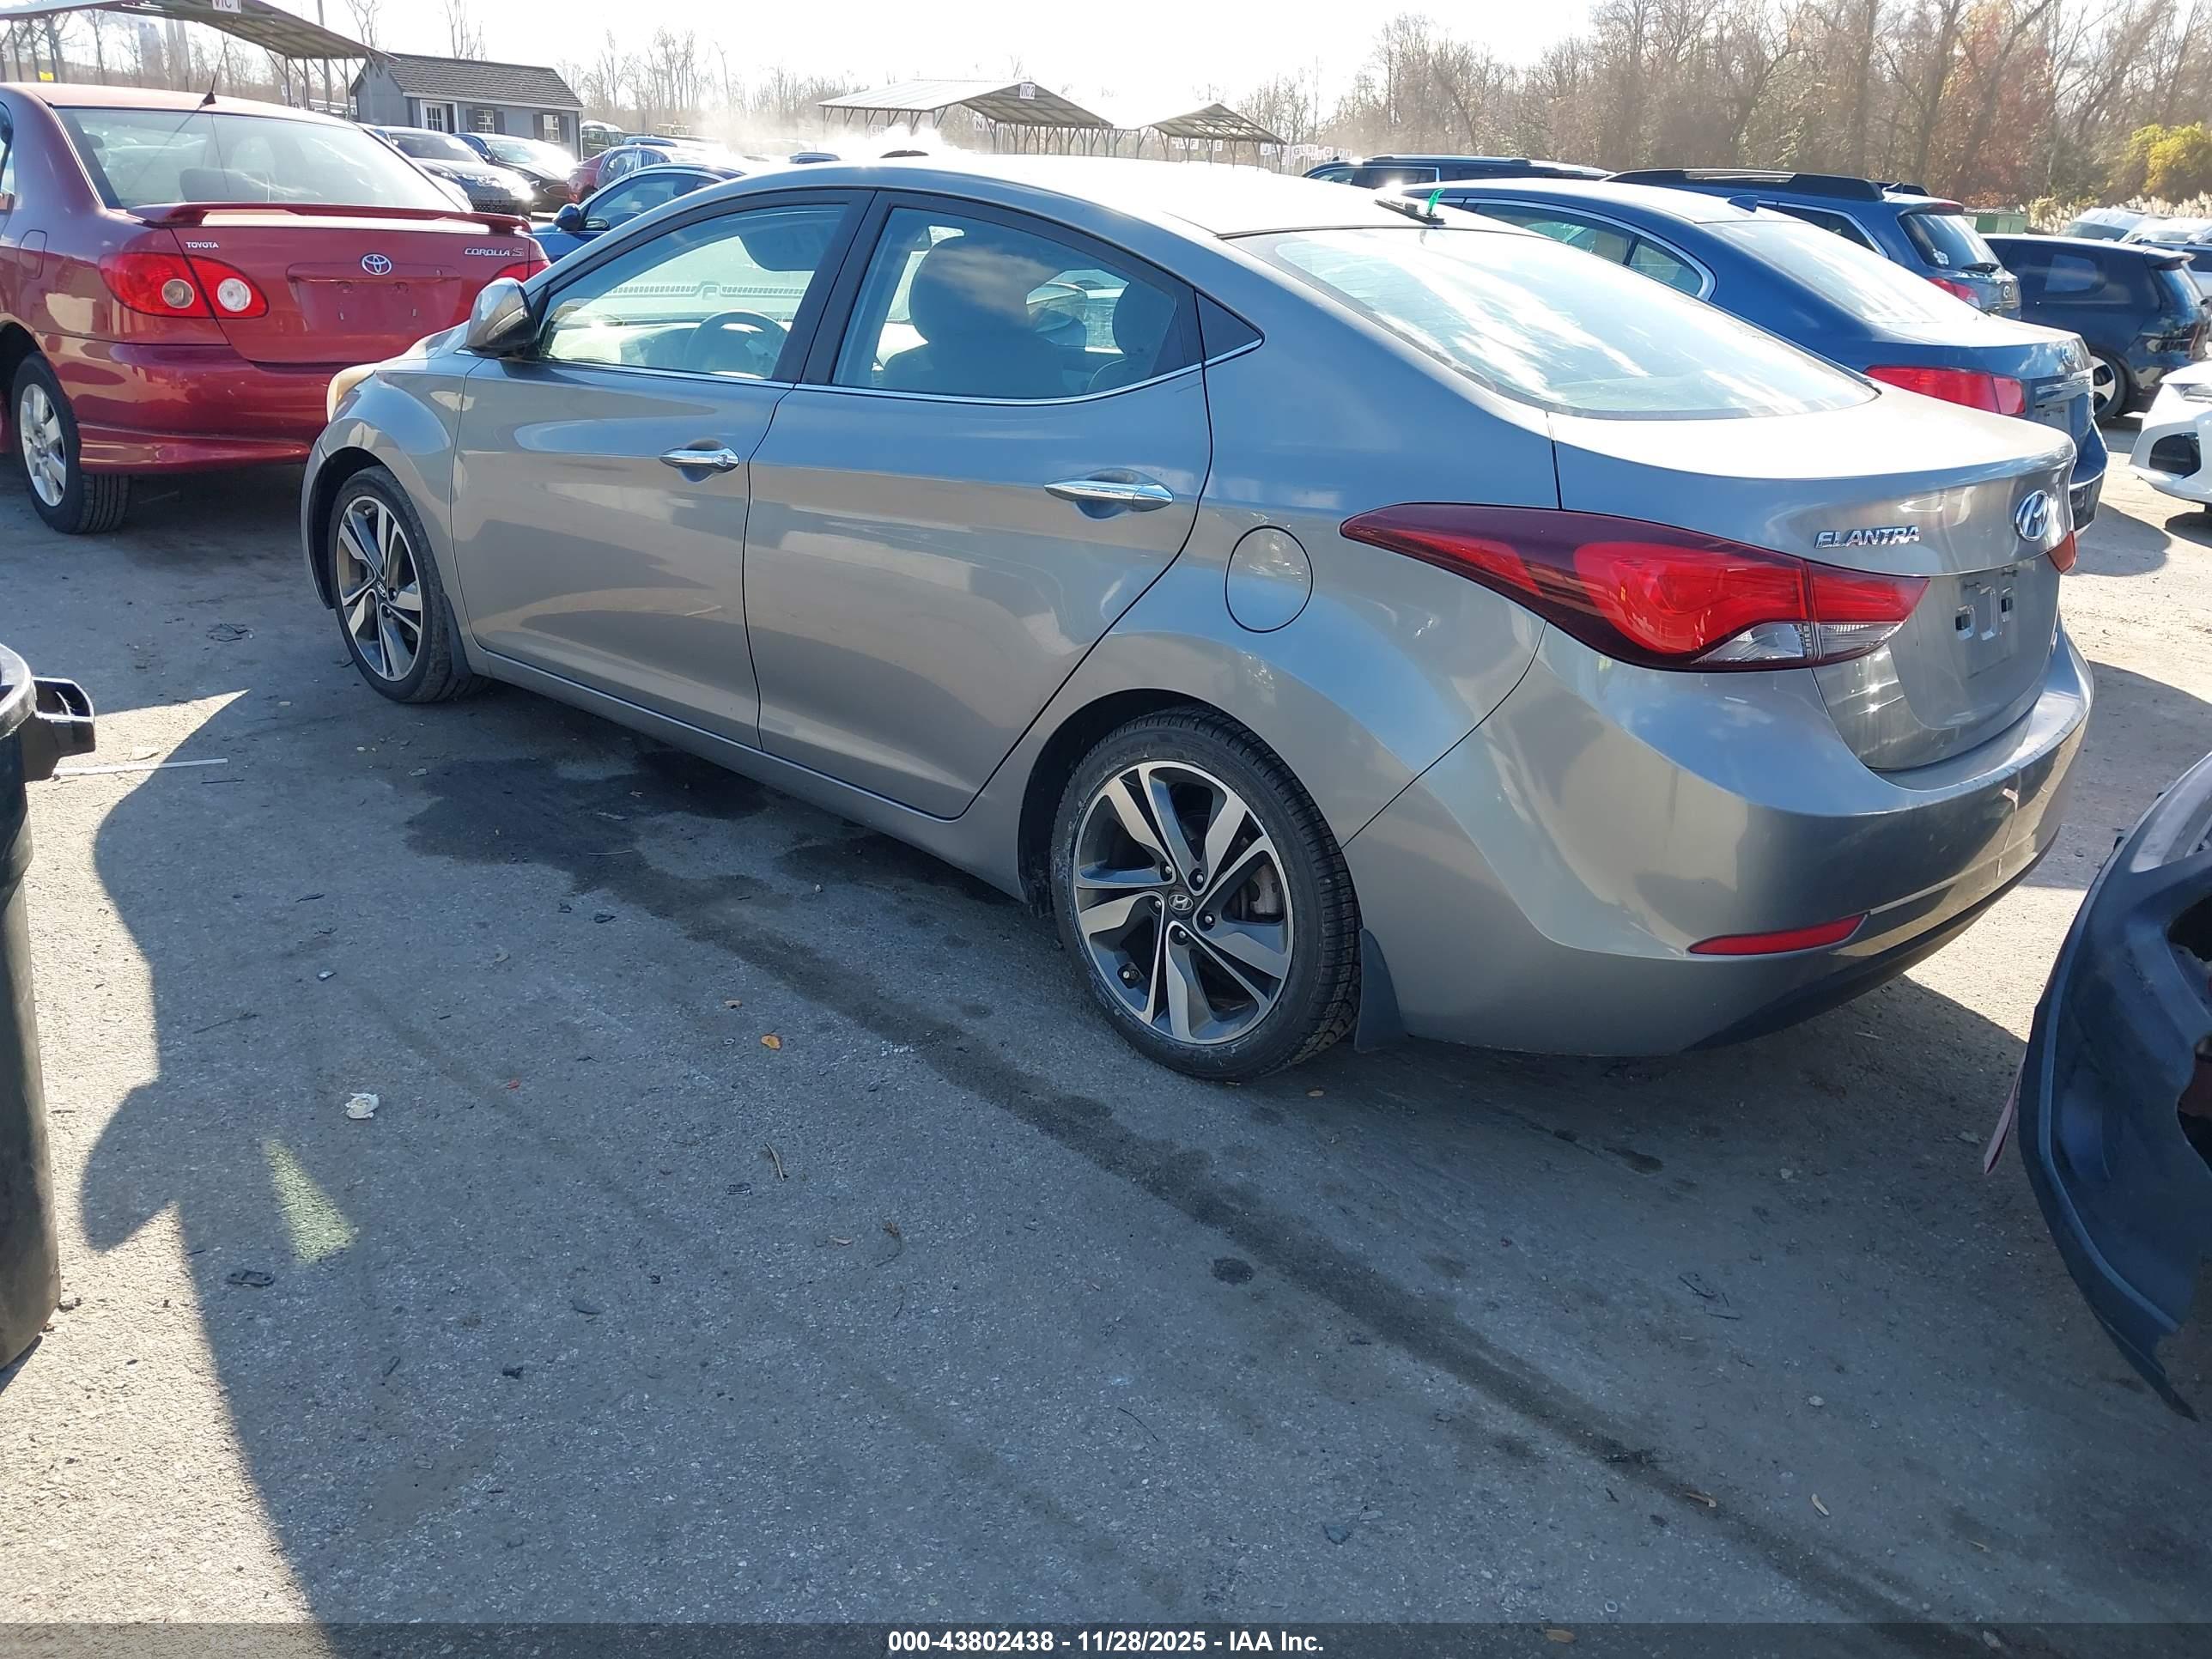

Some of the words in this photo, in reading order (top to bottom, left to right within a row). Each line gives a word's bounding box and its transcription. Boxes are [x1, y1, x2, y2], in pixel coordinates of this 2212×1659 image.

[464, 246, 511, 257] COROLLA
[511, 246, 525, 257] S
[1814, 525, 1920, 549] ELANTRA
